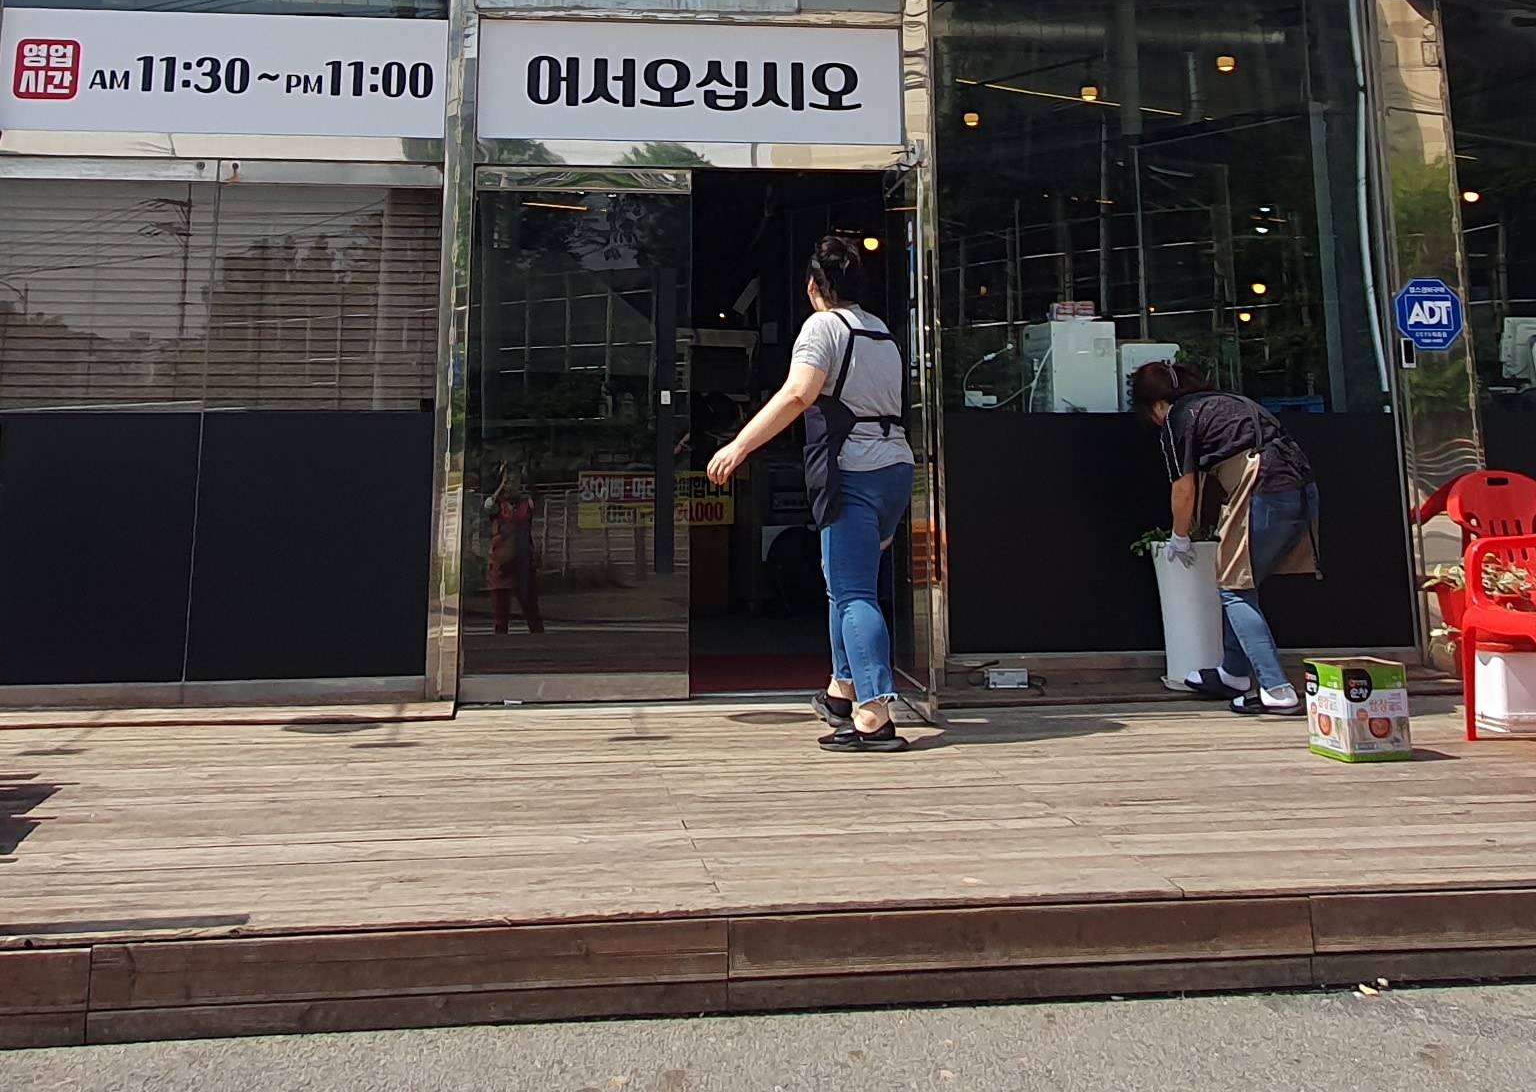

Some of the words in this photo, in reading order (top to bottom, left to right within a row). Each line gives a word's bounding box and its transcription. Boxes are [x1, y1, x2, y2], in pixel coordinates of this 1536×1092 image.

[23, 43, 73, 68] 영업
[18, 69, 72, 95] 시간
[526, 55, 863, 111] 어서오십시오
[1407, 300, 1452, 325] ADT
